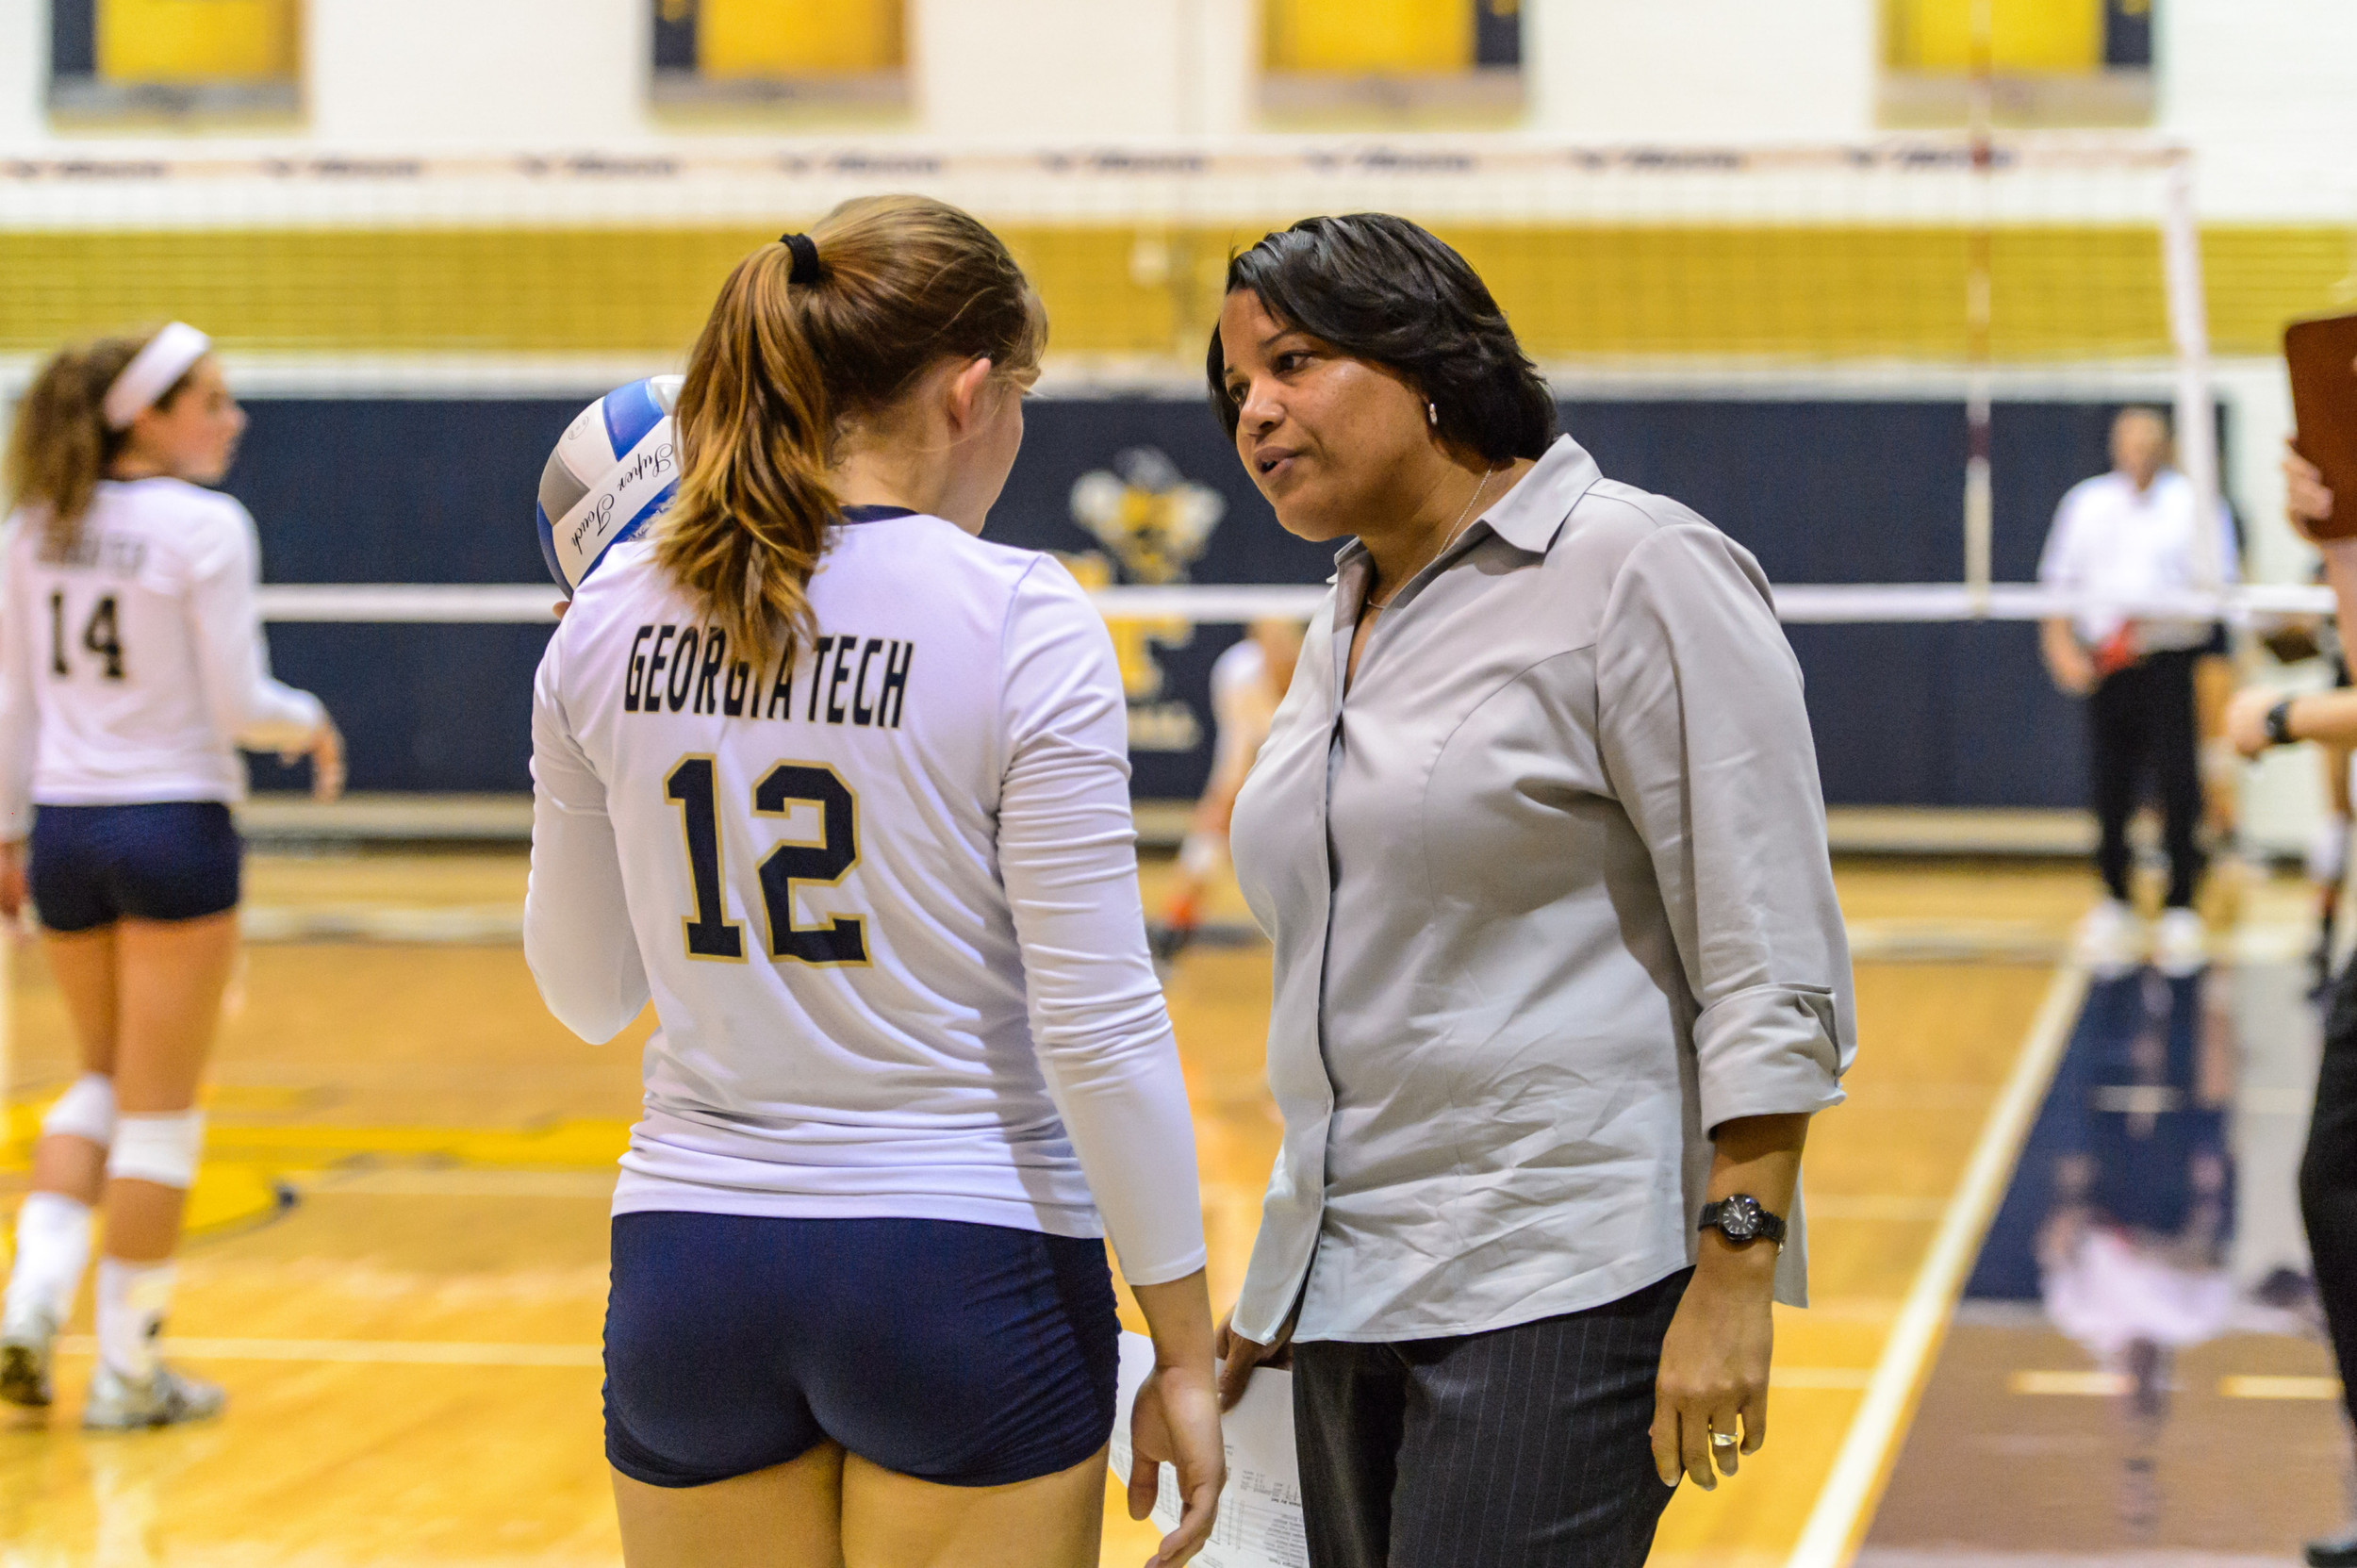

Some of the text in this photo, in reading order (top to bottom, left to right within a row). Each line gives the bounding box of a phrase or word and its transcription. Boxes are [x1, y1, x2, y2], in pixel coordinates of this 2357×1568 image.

[618, 442, 674, 492] Super
[570, 492, 615, 556] Touch
[49, 590, 127, 680] 14
[807, 634, 915, 730] TECH
[662, 751, 873, 969] 12
